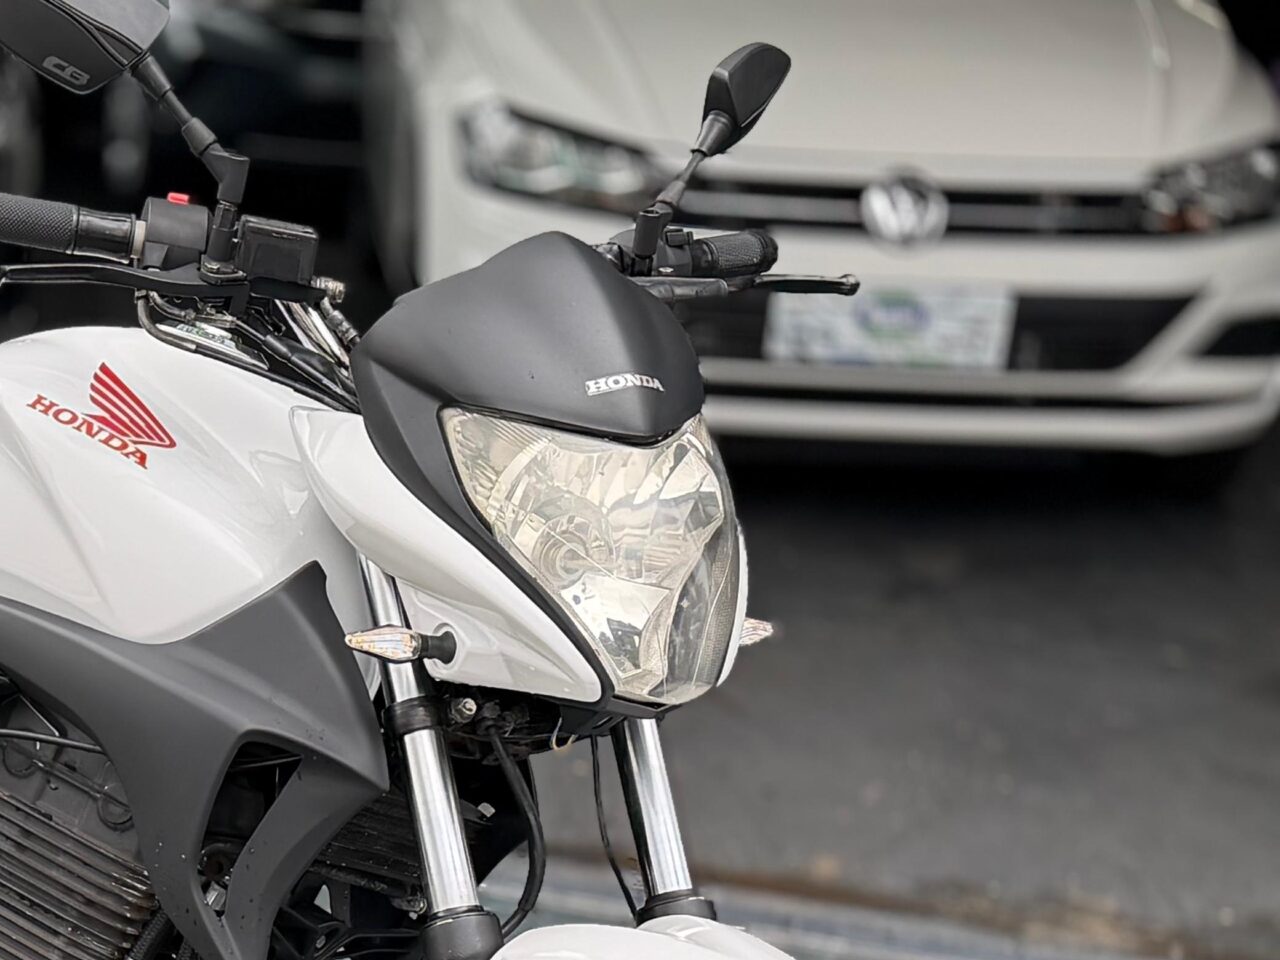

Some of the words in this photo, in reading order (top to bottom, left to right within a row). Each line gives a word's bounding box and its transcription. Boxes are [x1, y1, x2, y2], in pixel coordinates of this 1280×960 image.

[42, 56, 90, 85] CB
[585, 372, 665, 396] HONDA
[26, 394, 148, 470] HONDA
